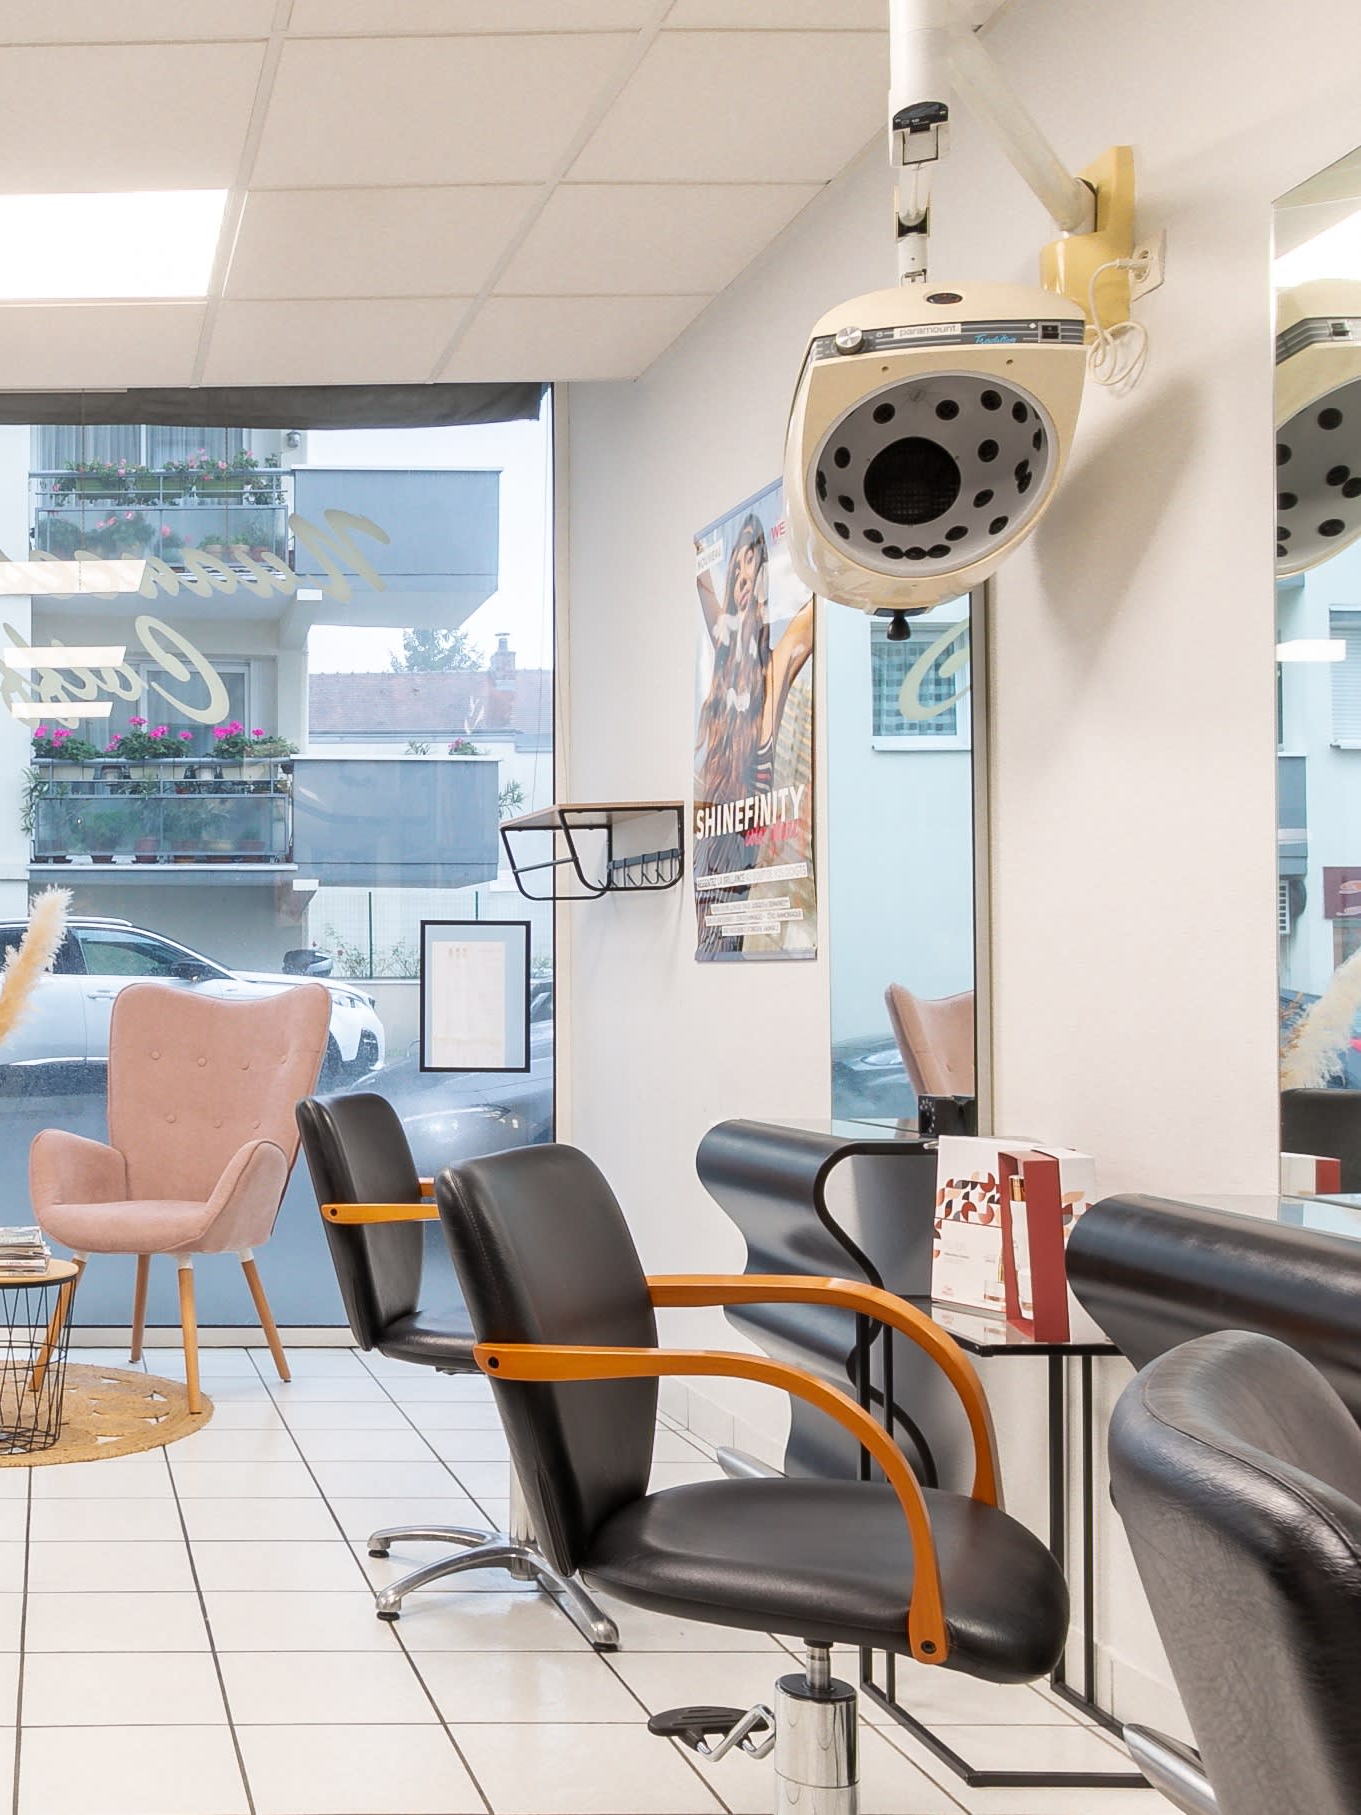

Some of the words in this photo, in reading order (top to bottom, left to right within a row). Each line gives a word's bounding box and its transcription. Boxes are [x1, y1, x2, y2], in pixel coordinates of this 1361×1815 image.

[898, 324, 957, 338] paramount
[770, 521, 787, 540] WE
[696, 784, 806, 840] SHINEFINITY
